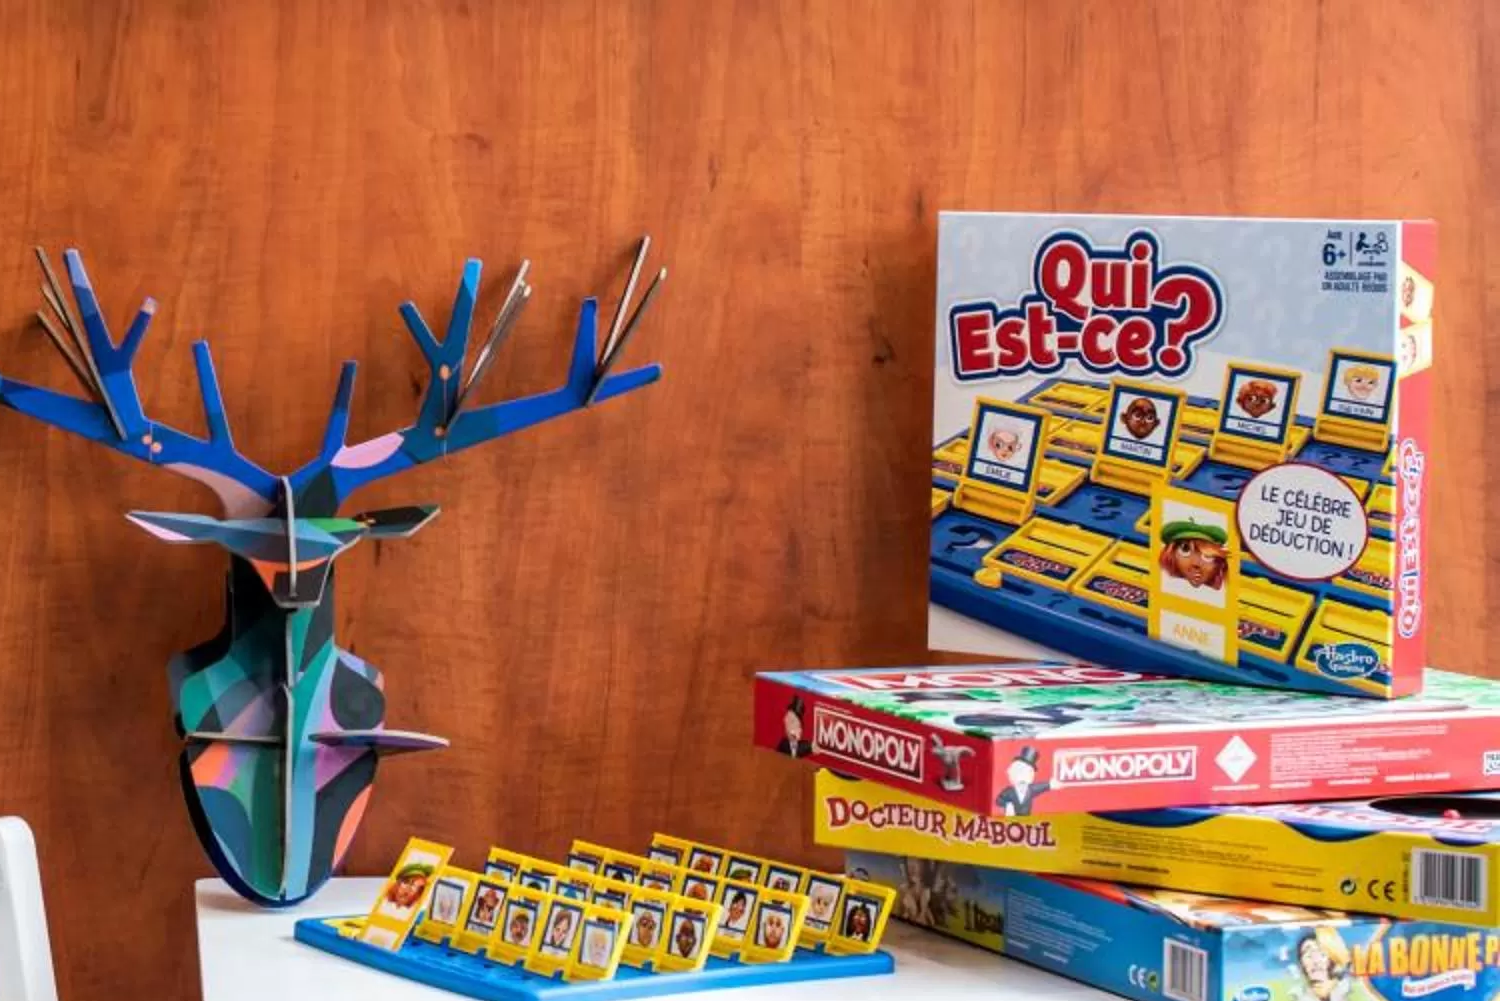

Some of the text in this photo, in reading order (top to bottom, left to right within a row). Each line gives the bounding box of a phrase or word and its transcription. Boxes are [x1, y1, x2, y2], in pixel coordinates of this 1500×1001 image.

[1323, 243, 1347, 266] 6+
[1041, 240, 1151, 320] Qui
[956, 276, 1217, 371] Est-ce?
[1261, 483, 1279, 503] LE
[1276, 509, 1333, 535] JEU DE
[1249, 523, 1344, 558] DÉDUCTION
[1313, 643, 1373, 665] Hasbro
[819, 716, 920, 772] MONOPOLY
[1059, 750, 1191, 780] MONOPOLY
[826, 796, 1056, 847] DOCTEUR MABOUL
[1352, 940, 1385, 976] LA
[1389, 932, 1483, 977] BONNE
